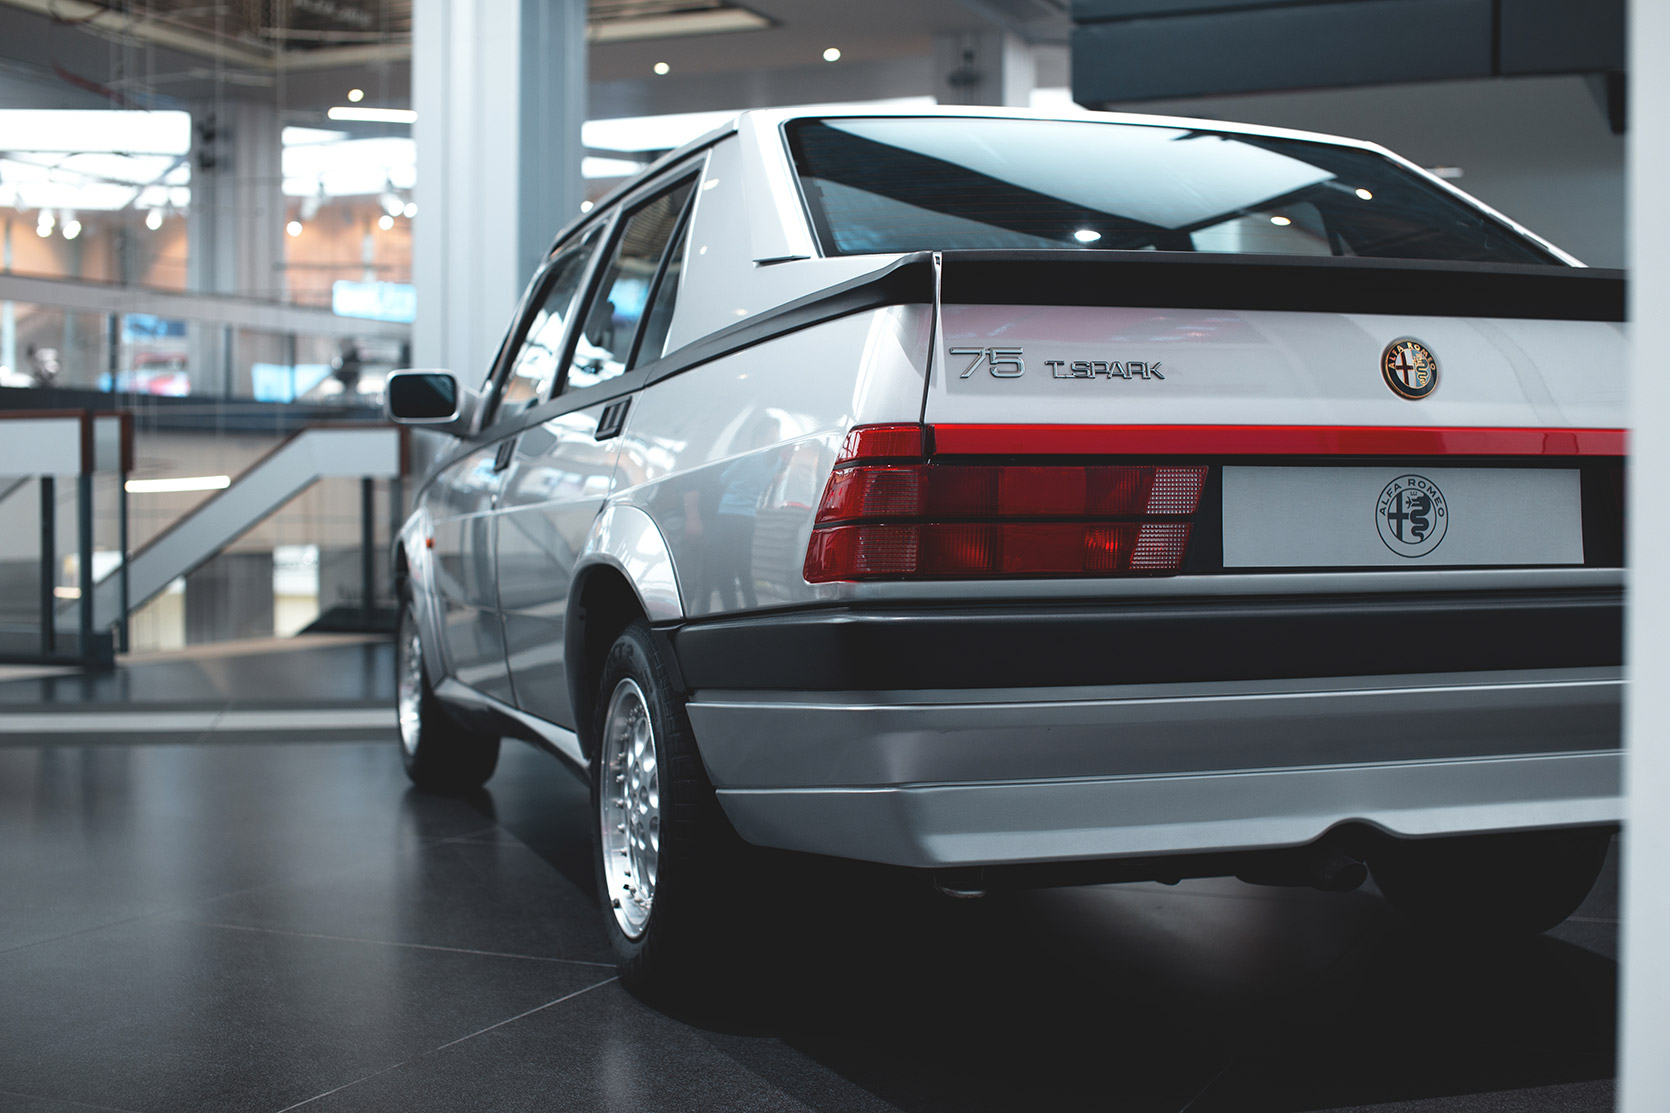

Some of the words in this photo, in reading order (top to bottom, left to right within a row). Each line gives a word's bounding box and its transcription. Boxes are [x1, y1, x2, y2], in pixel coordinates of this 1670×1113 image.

[949, 346, 1026, 379] 75
[1388, 344, 1405, 370] ALFA
[1406, 341, 1437, 371] ROMEO
[1379, 482, 1402, 516] ALFA
[1407, 478, 1445, 518] ROMEO
